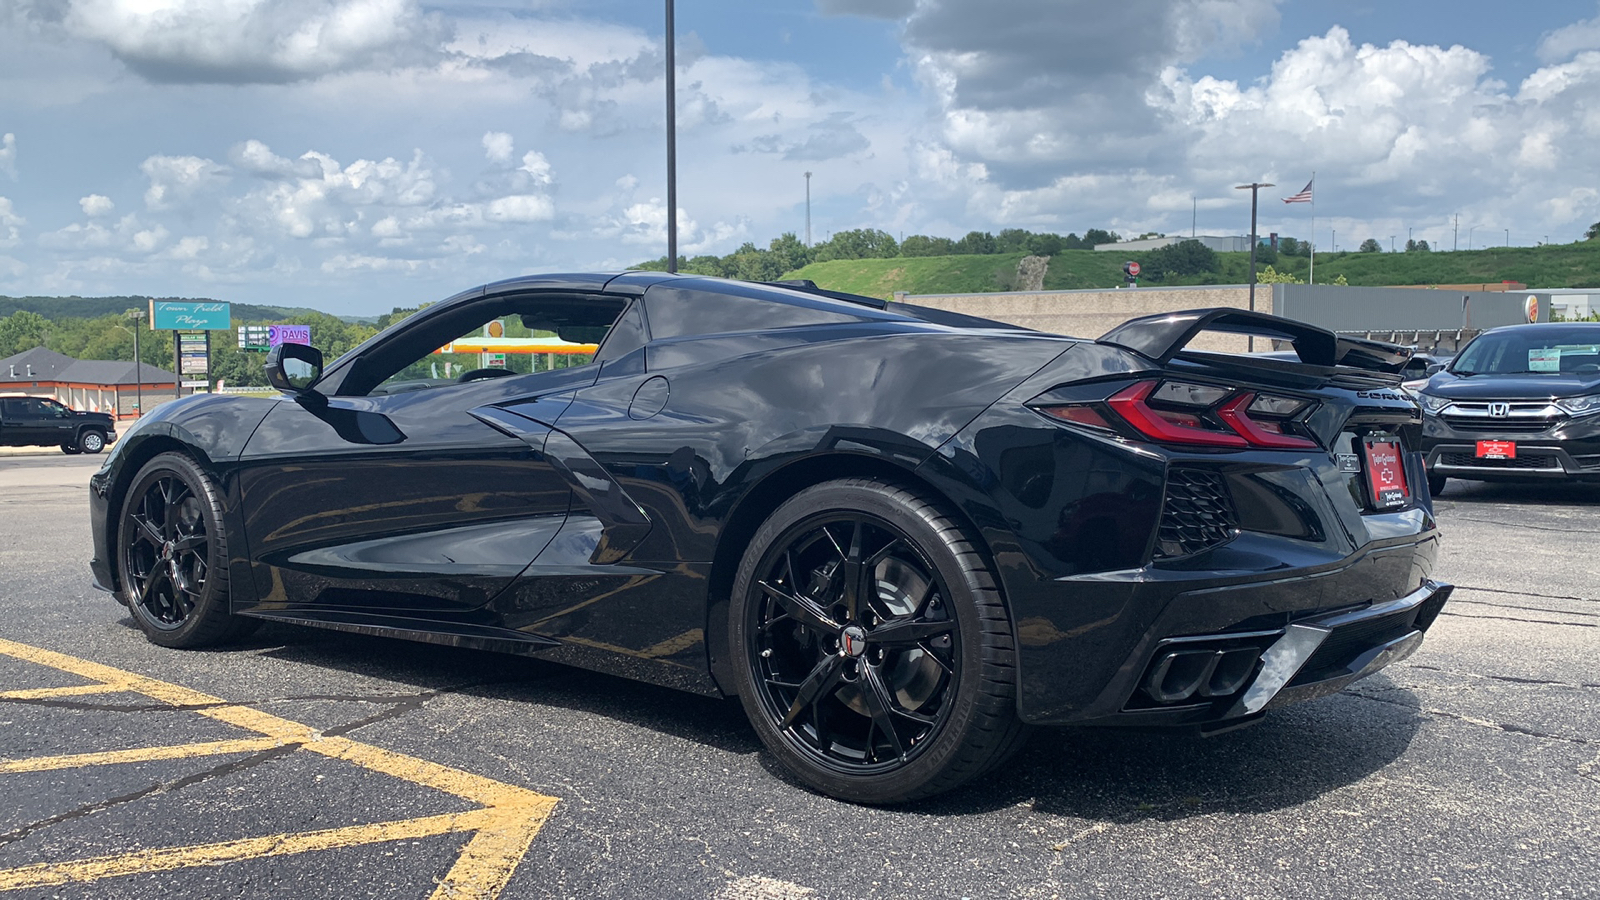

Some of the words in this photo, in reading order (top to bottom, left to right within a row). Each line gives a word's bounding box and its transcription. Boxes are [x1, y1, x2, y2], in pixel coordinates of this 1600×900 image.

[159, 302, 188, 312] Town
[193, 303, 225, 313] Field
[175, 315, 209, 328] Plaza
[282, 330, 308, 339] DAVIS
